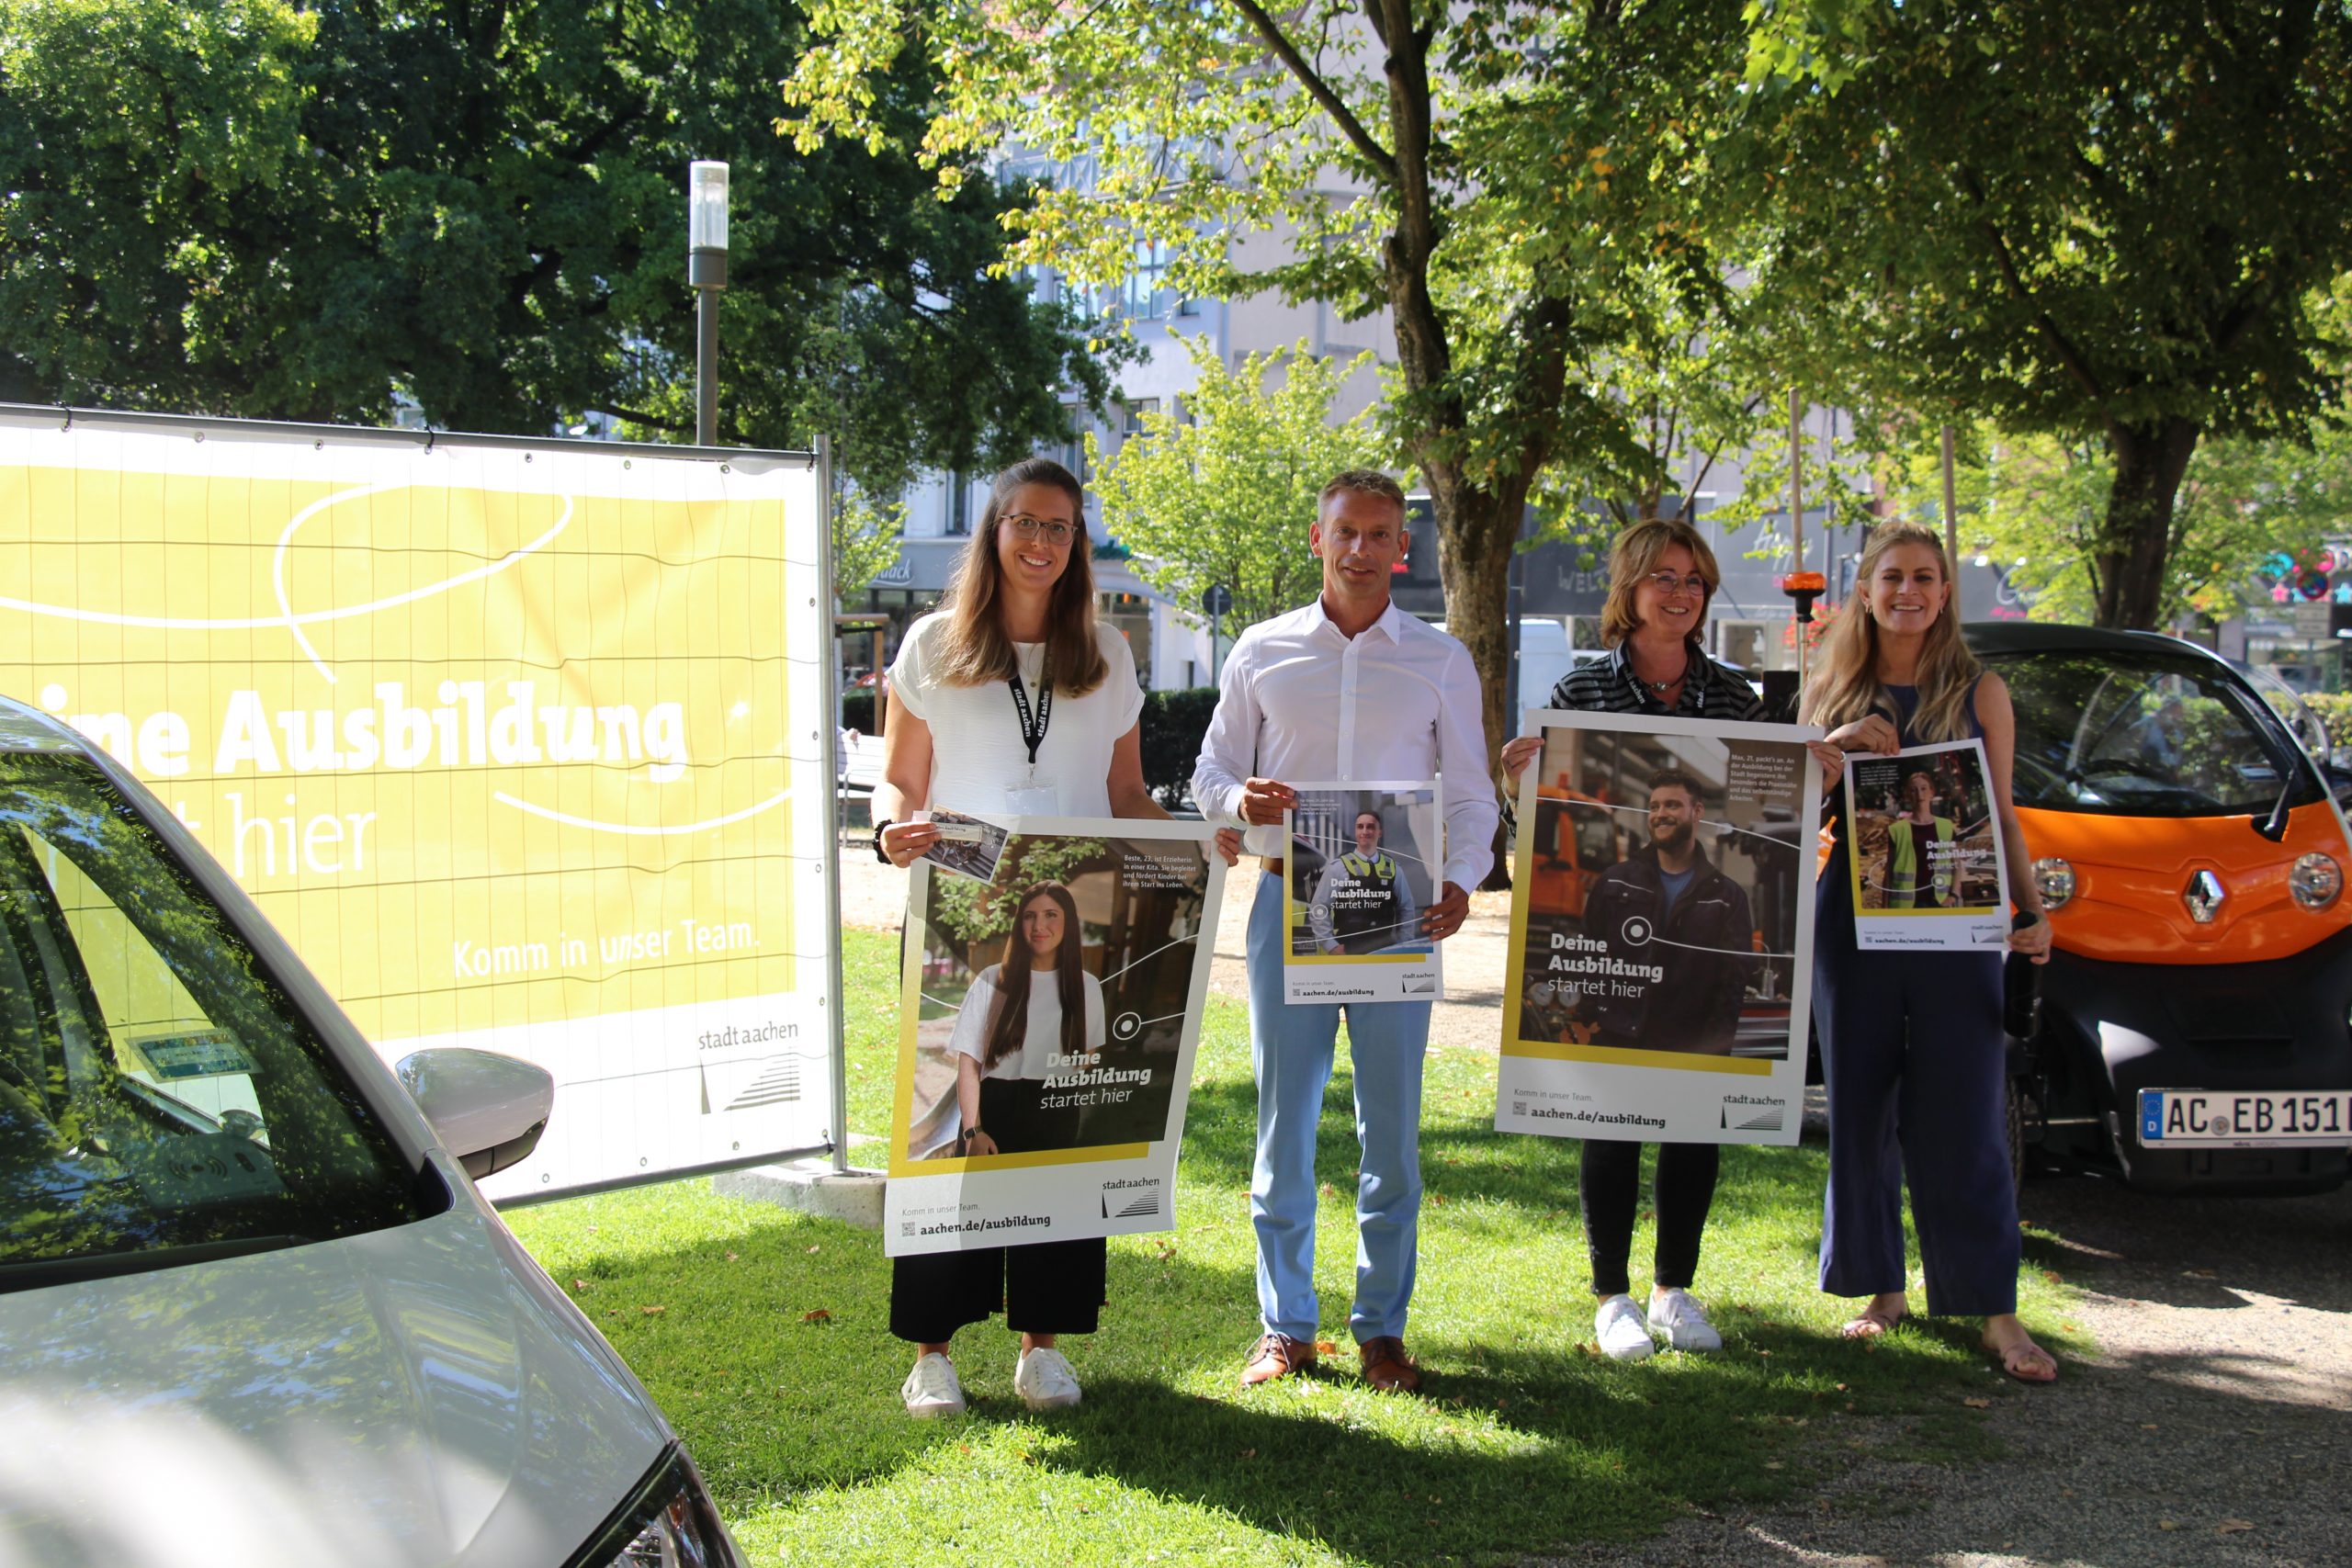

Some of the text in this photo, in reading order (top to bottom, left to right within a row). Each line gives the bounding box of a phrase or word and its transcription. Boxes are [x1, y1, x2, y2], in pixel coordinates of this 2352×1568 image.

[1014, 688, 1031, 738] stadt aachen
[214, 680, 687, 783] Ausbildung
[1037, 716, 1046, 737] stadt
[225, 793, 377, 878] hier
[1125, 854, 1142, 863] Beste,
[1927, 849, 1986, 860] Ausbildung
[1330, 878, 1362, 887] Deine
[1330, 889, 1391, 900] Ausbildung
[1330, 900, 1362, 909] startet
[454, 919, 761, 978] Komm in unser Team.
[1551, 933, 1608, 953] Deine
[1548, 955, 1663, 983] Ausbildung
[1547, 976, 1645, 998] startet hier
[698, 1021, 798, 1050] stadt aachen
[1046, 1050, 1101, 1067] Deine
[1042, 1067, 1152, 1089] Ausbildung
[1040, 1088, 1133, 1109] startet hier
[1514, 1089, 1538, 1097] Komm
[1540, 1090, 1547, 1099] in
[1549, 1092, 1569, 1100] unser
[1723, 1094, 1785, 1106] stadt aachen
[1531, 1108, 1666, 1129] aachen.de/ausbildung
[2148, 1097, 2352, 1133] D AC EB 151
[1102, 1177, 1159, 1190] stadt aachen
[959, 1203, 980, 1212] Team.
[921, 1215, 1051, 1235] aachen.de/ausbildung
